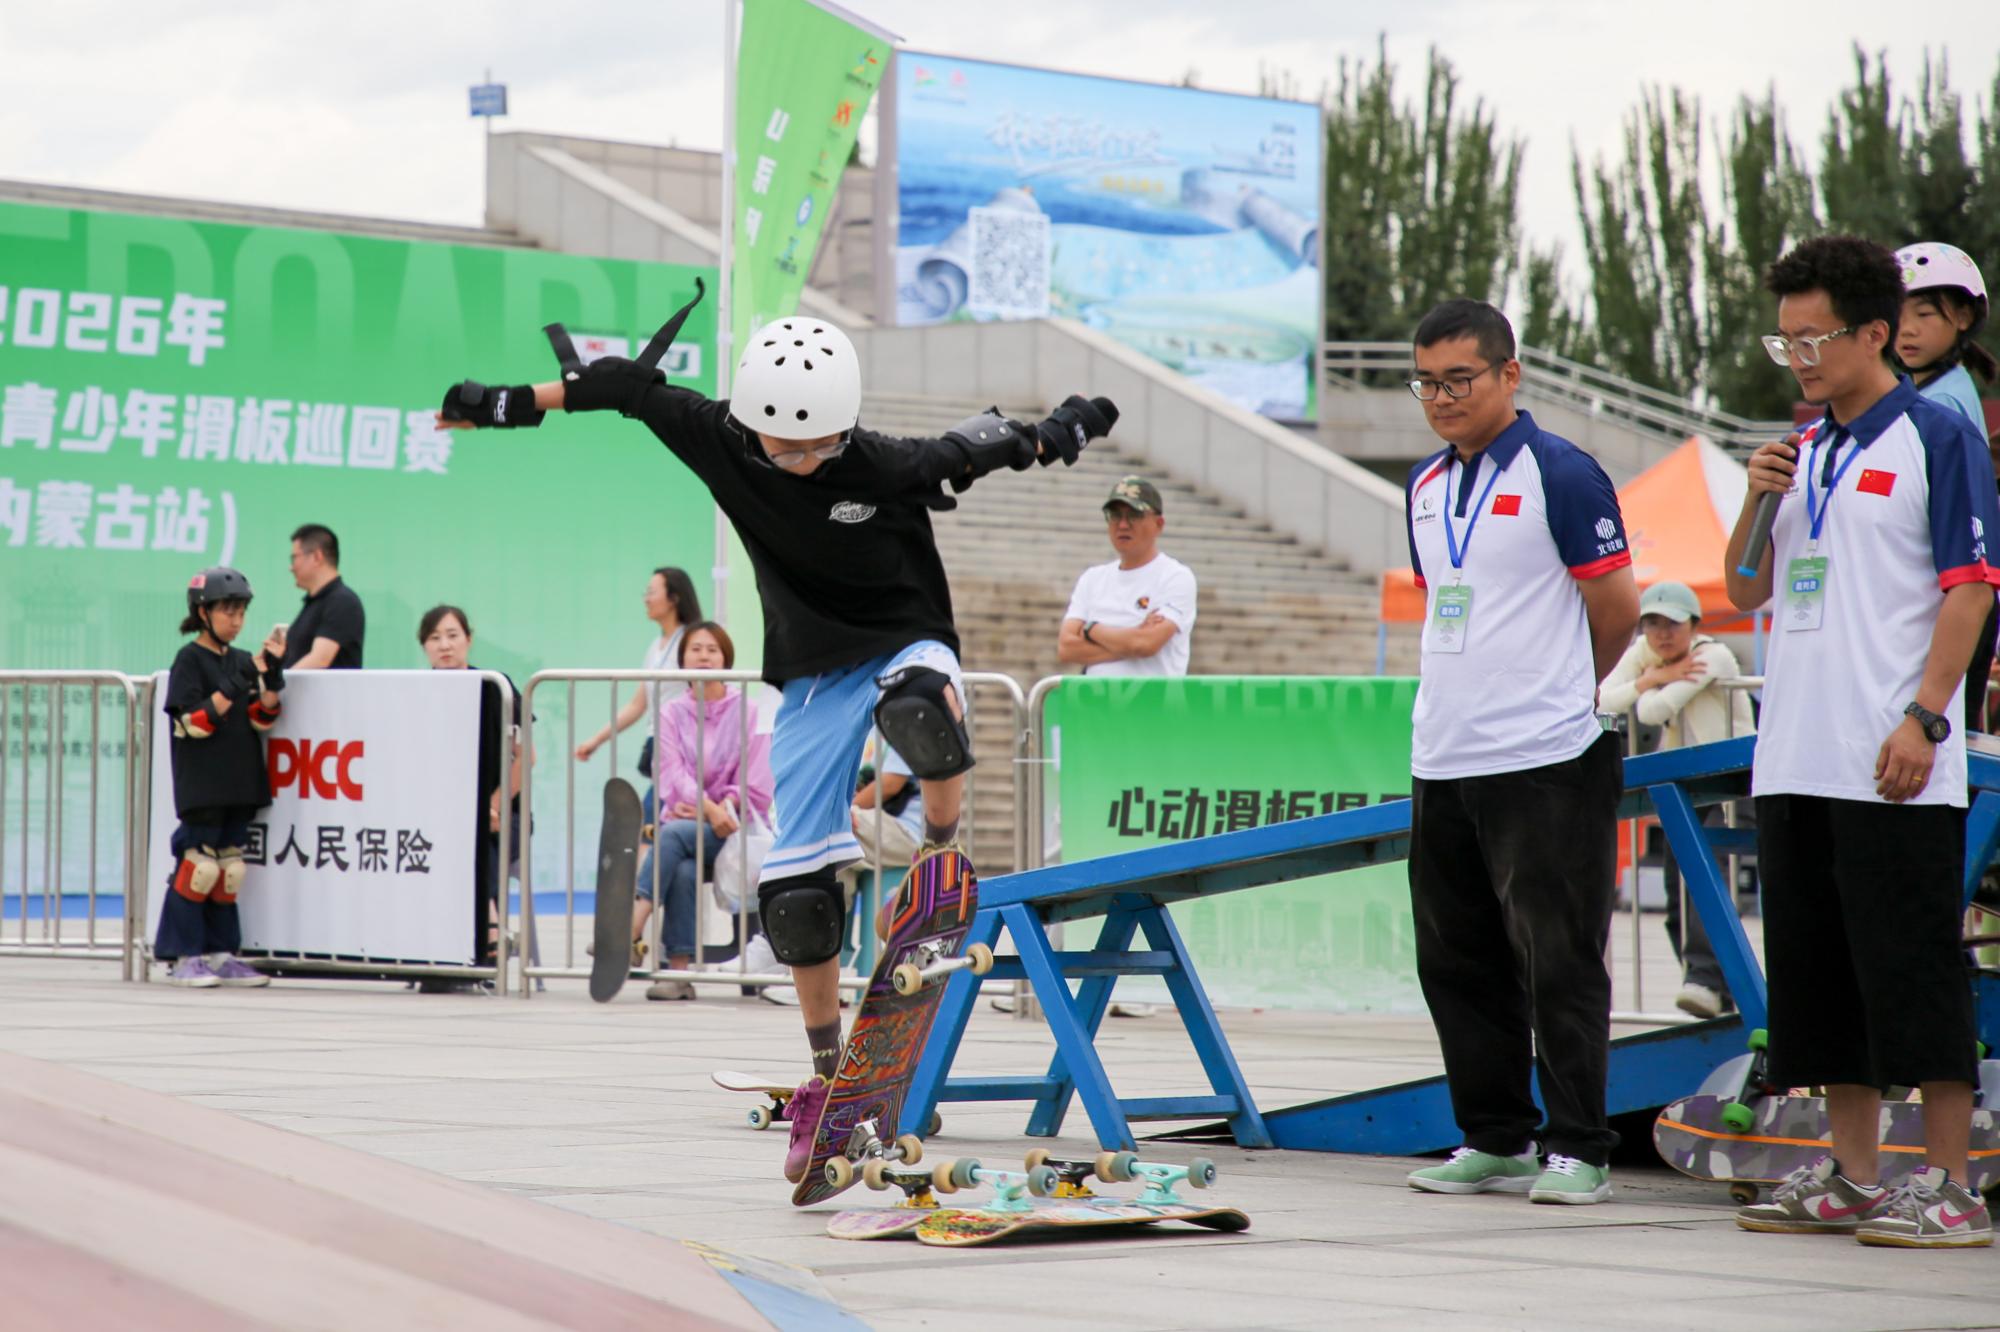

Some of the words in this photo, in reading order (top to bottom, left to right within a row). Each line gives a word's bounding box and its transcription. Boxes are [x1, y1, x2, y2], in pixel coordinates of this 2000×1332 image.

[0, 286, 227, 367] 026年
[0, 382, 454, 475] 青少年滑板巡回赛
[267, 738, 365, 801] PICC
